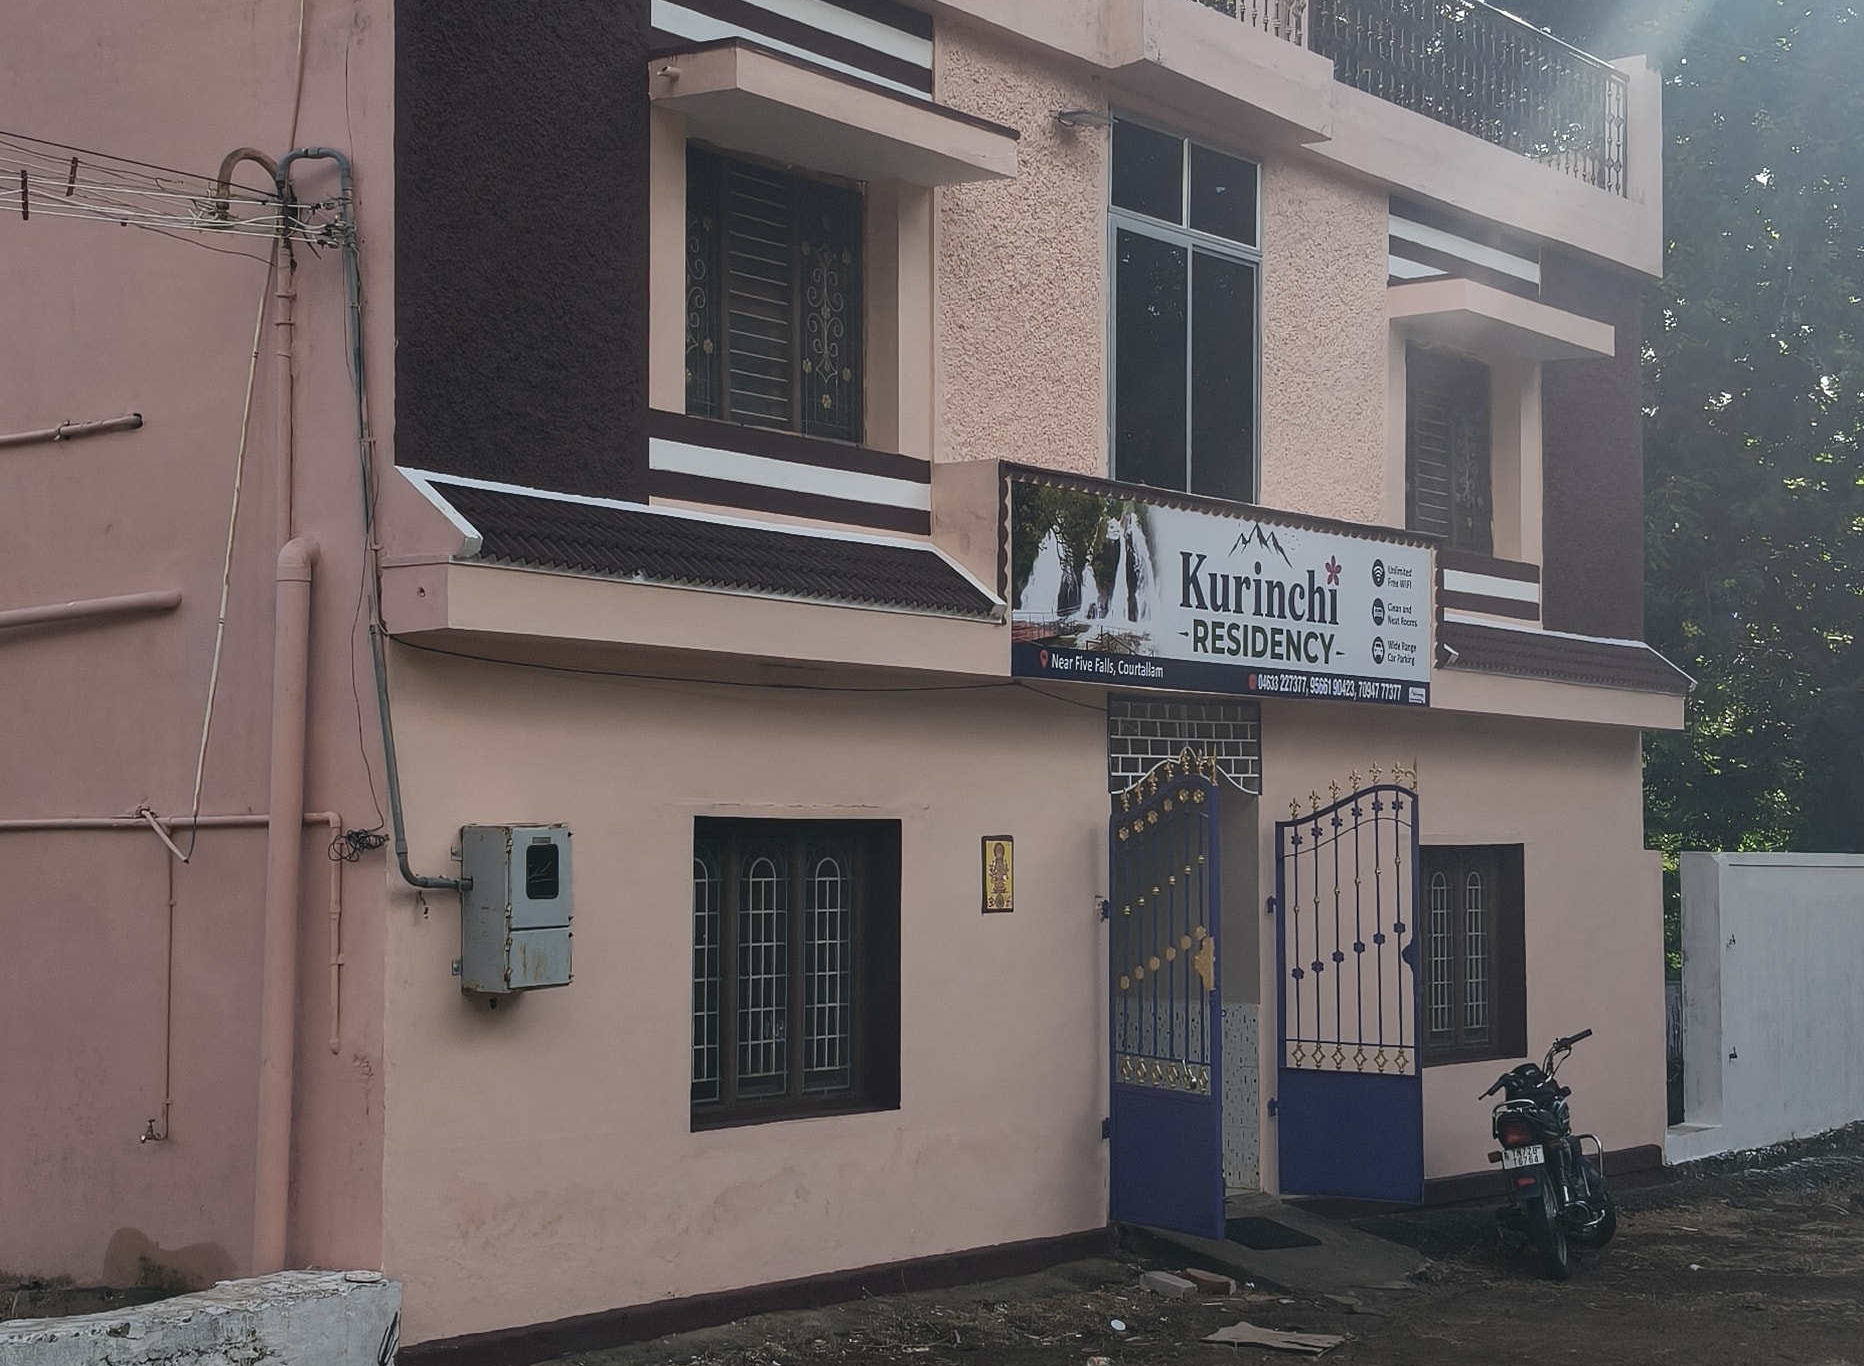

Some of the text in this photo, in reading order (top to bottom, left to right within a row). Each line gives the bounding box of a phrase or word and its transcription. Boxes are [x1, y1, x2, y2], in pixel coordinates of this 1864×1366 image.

[1179, 551, 1340, 625] Kurinchi
[1193, 618, 1335, 664] RESIDENCY
[1051, 653, 1164, 679] Near Five Falls, Courtallam
[1258, 674, 1279, 691] 04633
[1280, 673, 1309, 697] 227377,
[1332, 678, 1356, 701] 90423,
[1358, 681, 1380, 699] 70947
[1380, 682, 1402, 701] 77377
